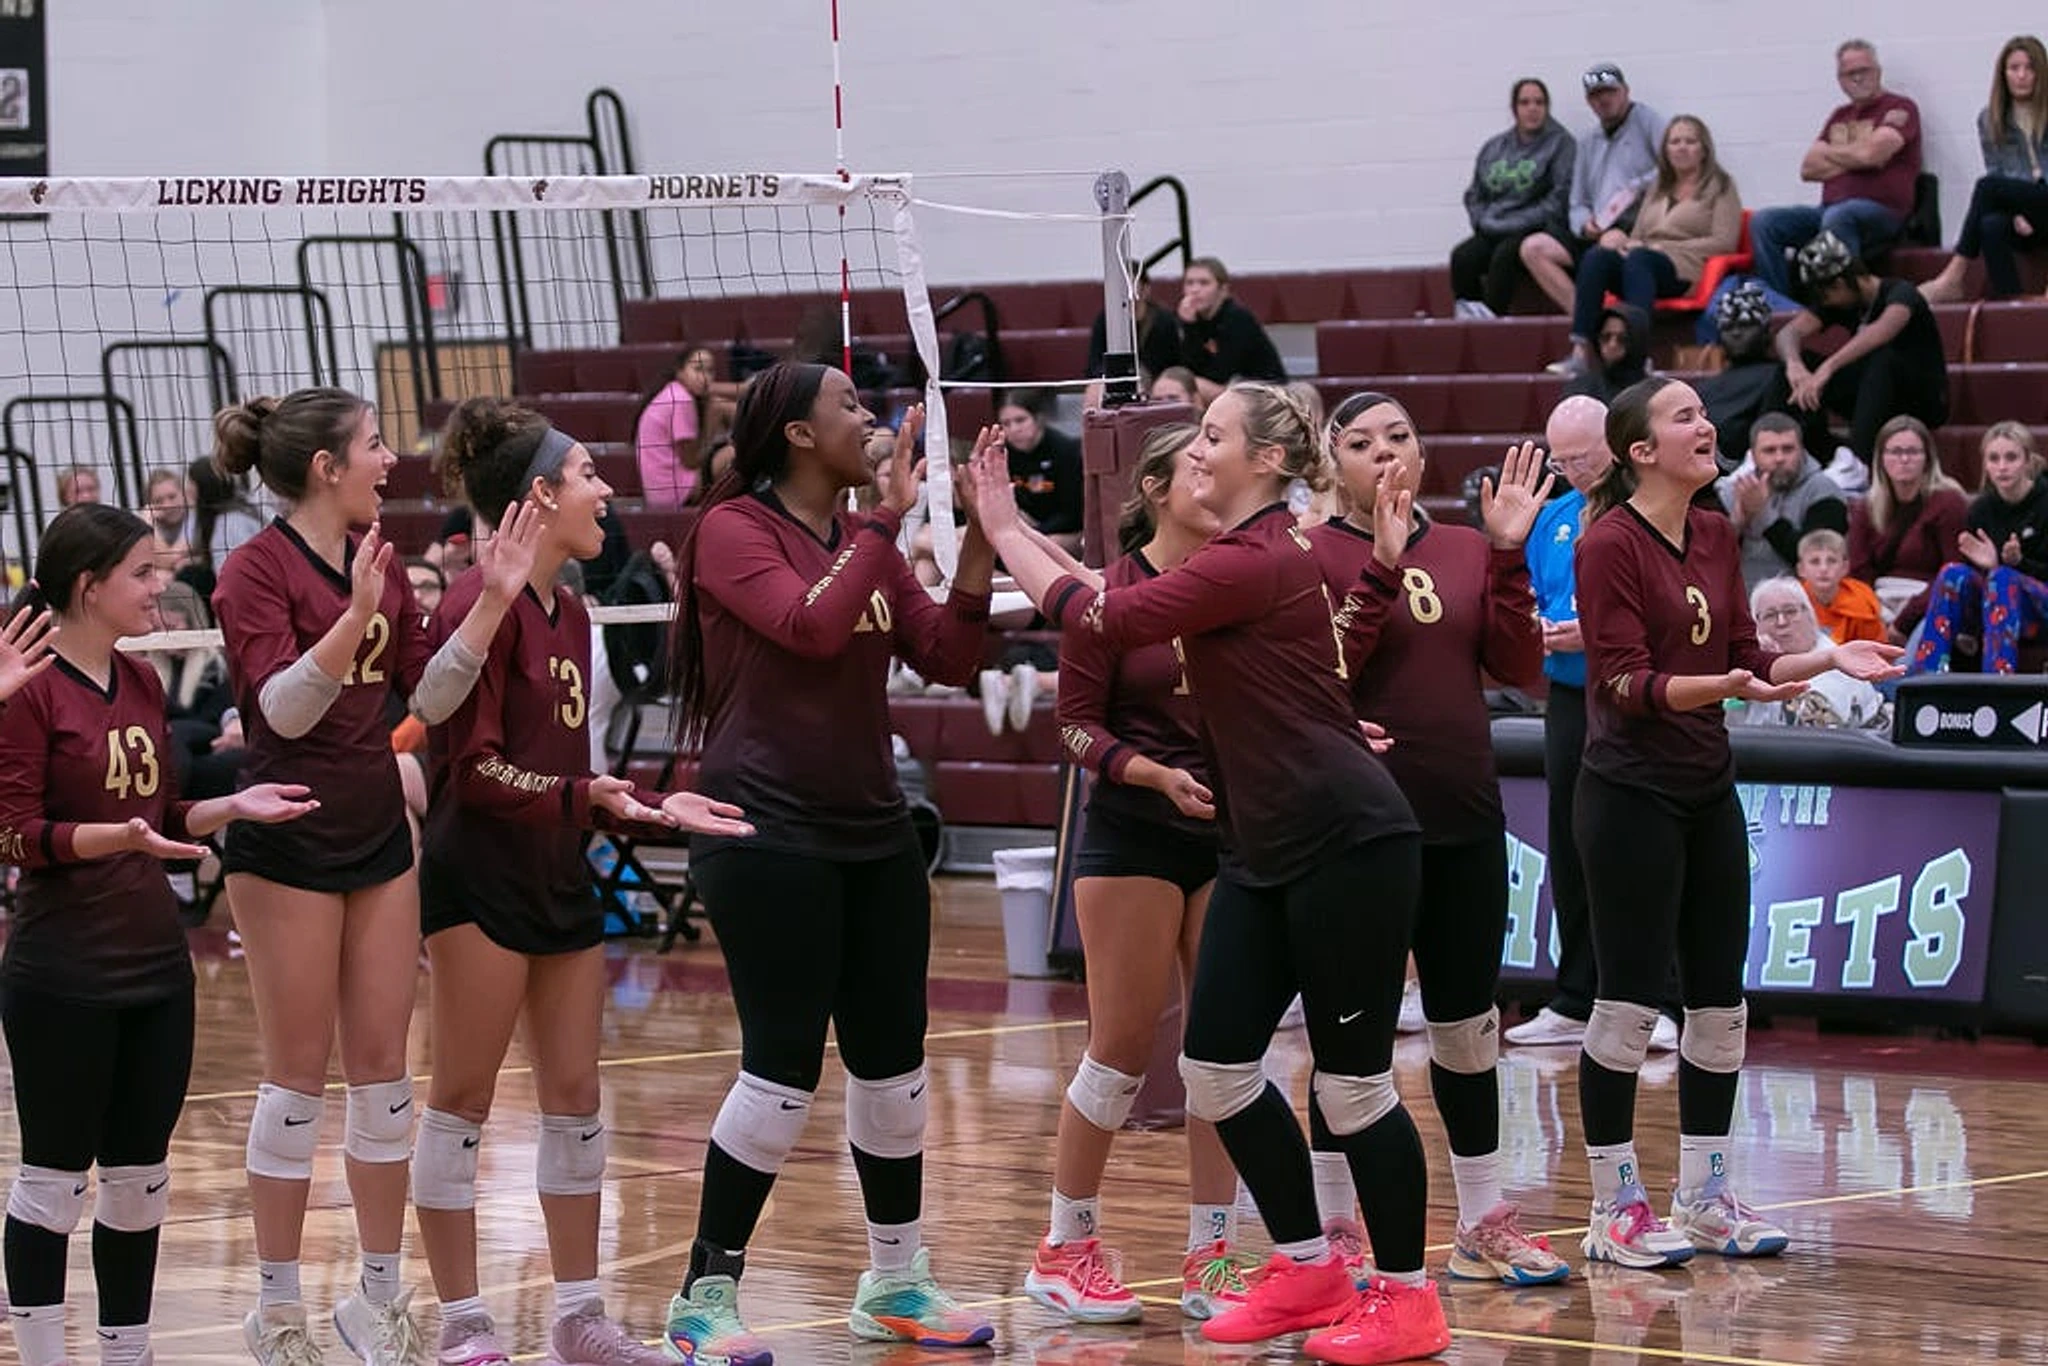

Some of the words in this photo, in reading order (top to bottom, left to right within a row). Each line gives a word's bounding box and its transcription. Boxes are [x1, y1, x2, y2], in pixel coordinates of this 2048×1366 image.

[157, 178, 283, 205] LICKING
[296, 178, 426, 205] HEIGHTS
[649, 174, 780, 200] HORNETS
[1402, 567, 1444, 624] 8
[1685, 585, 1712, 646] 3
[343, 611, 390, 685] 2
[105, 725, 160, 800] 43
